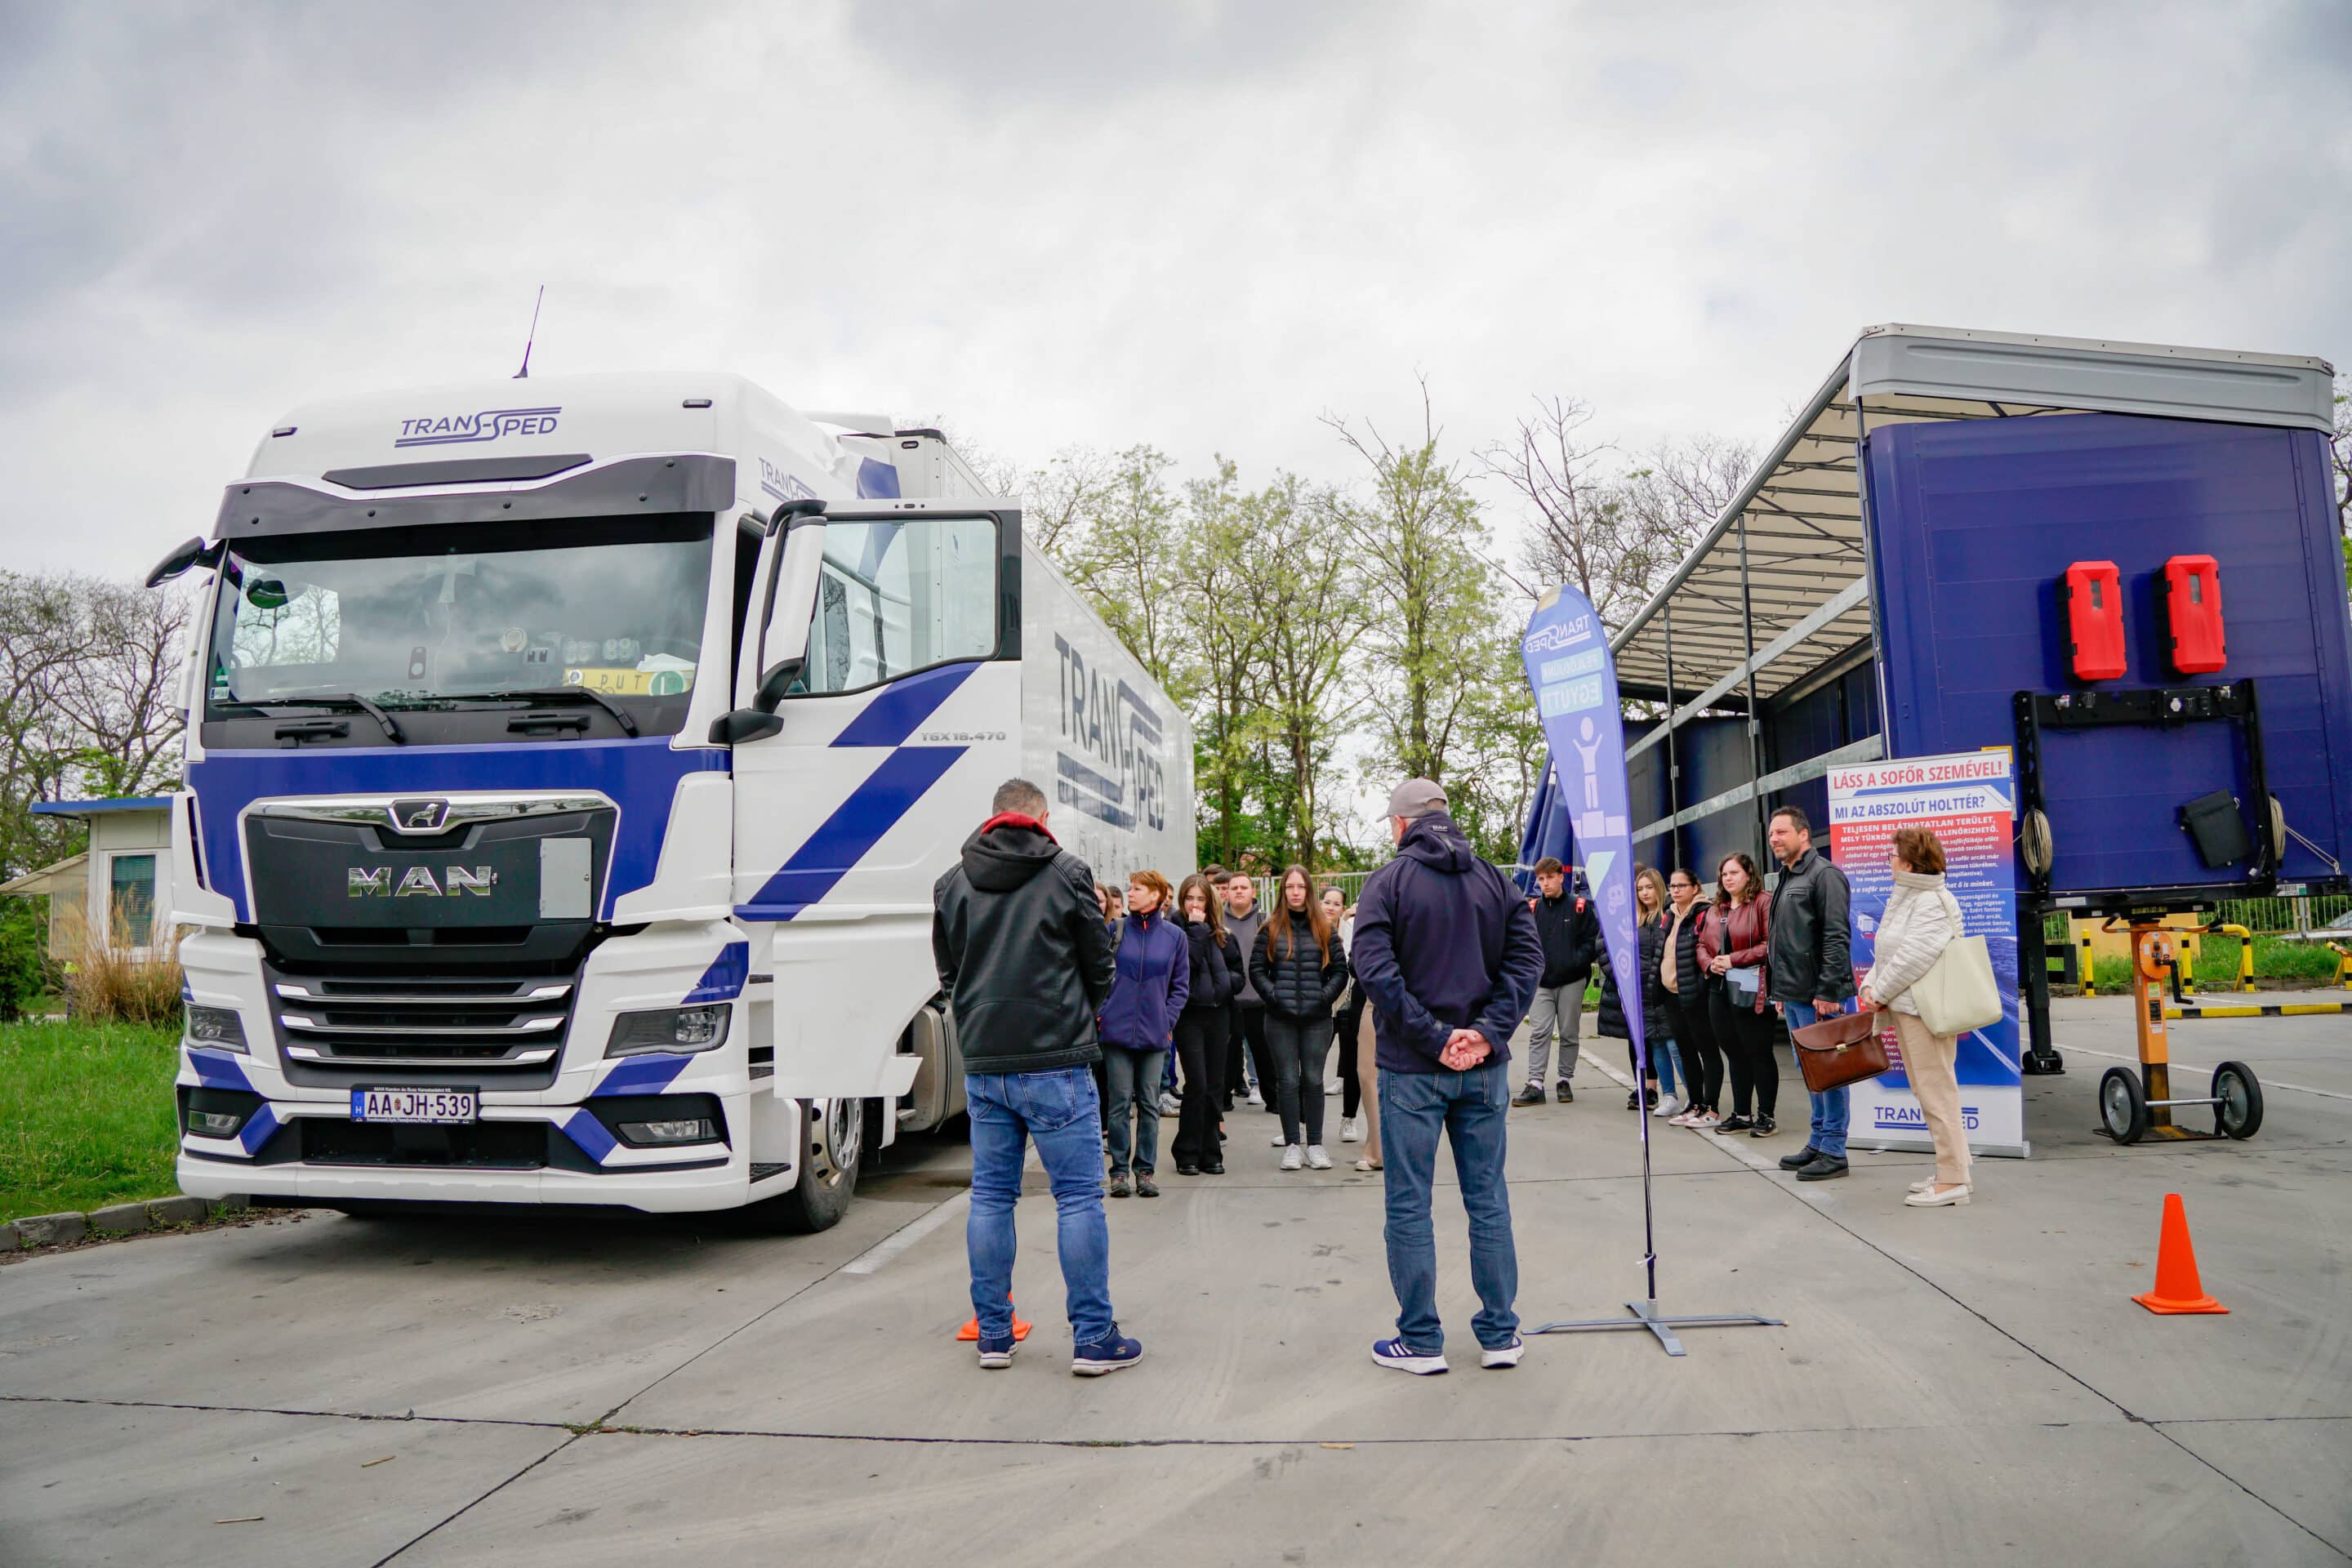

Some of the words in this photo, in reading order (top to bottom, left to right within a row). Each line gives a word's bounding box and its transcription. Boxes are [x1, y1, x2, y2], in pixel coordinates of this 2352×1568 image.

[394, 407, 562, 448] TRANS-SPED
[1833, 772, 1863, 790] LÁSS
[1867, 775, 1877, 786] A
[1881, 765, 1924, 786] SOFŐR
[1929, 760, 2002, 782] SZEMÉVEL!
[1835, 807, 1848, 819] MI
[1851, 805, 1865, 817] AZ
[1868, 799, 1926, 817] ABSZOLÚT
[1929, 794, 1985, 812] HOLTTÉR?
[1842, 824, 1879, 834] TELJESEN
[1882, 818, 1953, 831] BELÁTHATATLAN
[1956, 815, 1996, 826] TERÜLET,
[1935, 825, 1998, 836] ELLENŐRIZHETŐ.
[1841, 835, 1860, 844] MELY
[348, 866, 492, 898] MAN
[355, 1106, 362, 1114] H
[368, 1094, 392, 1116] AA
[403, 1095, 470, 1116] JH-539
